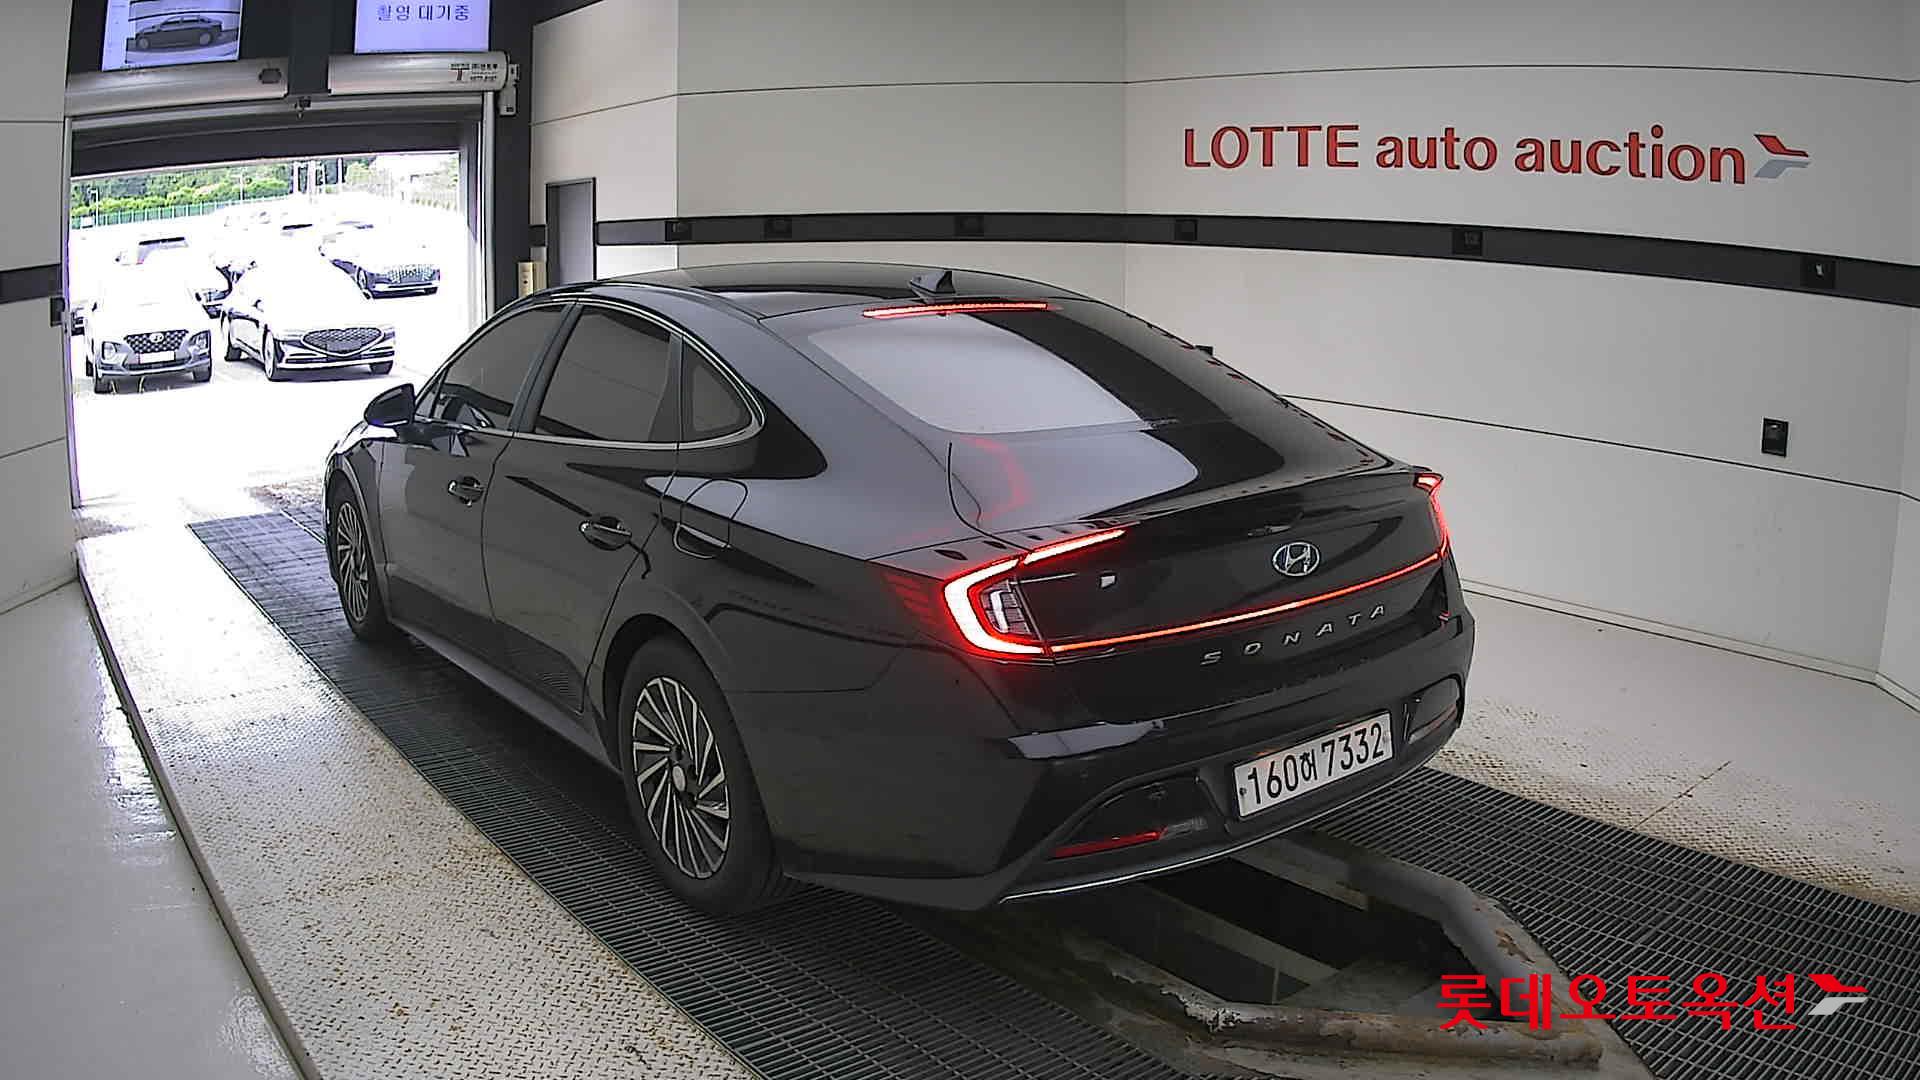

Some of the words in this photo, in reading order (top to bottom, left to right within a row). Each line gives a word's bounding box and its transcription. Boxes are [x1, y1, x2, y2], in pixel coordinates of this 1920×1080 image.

[1184, 124, 1361, 169] LOTTE
[1375, 127, 1498, 170] auto
[1515, 124, 1746, 184] auction
[1200, 604, 1386, 666] SONATA
